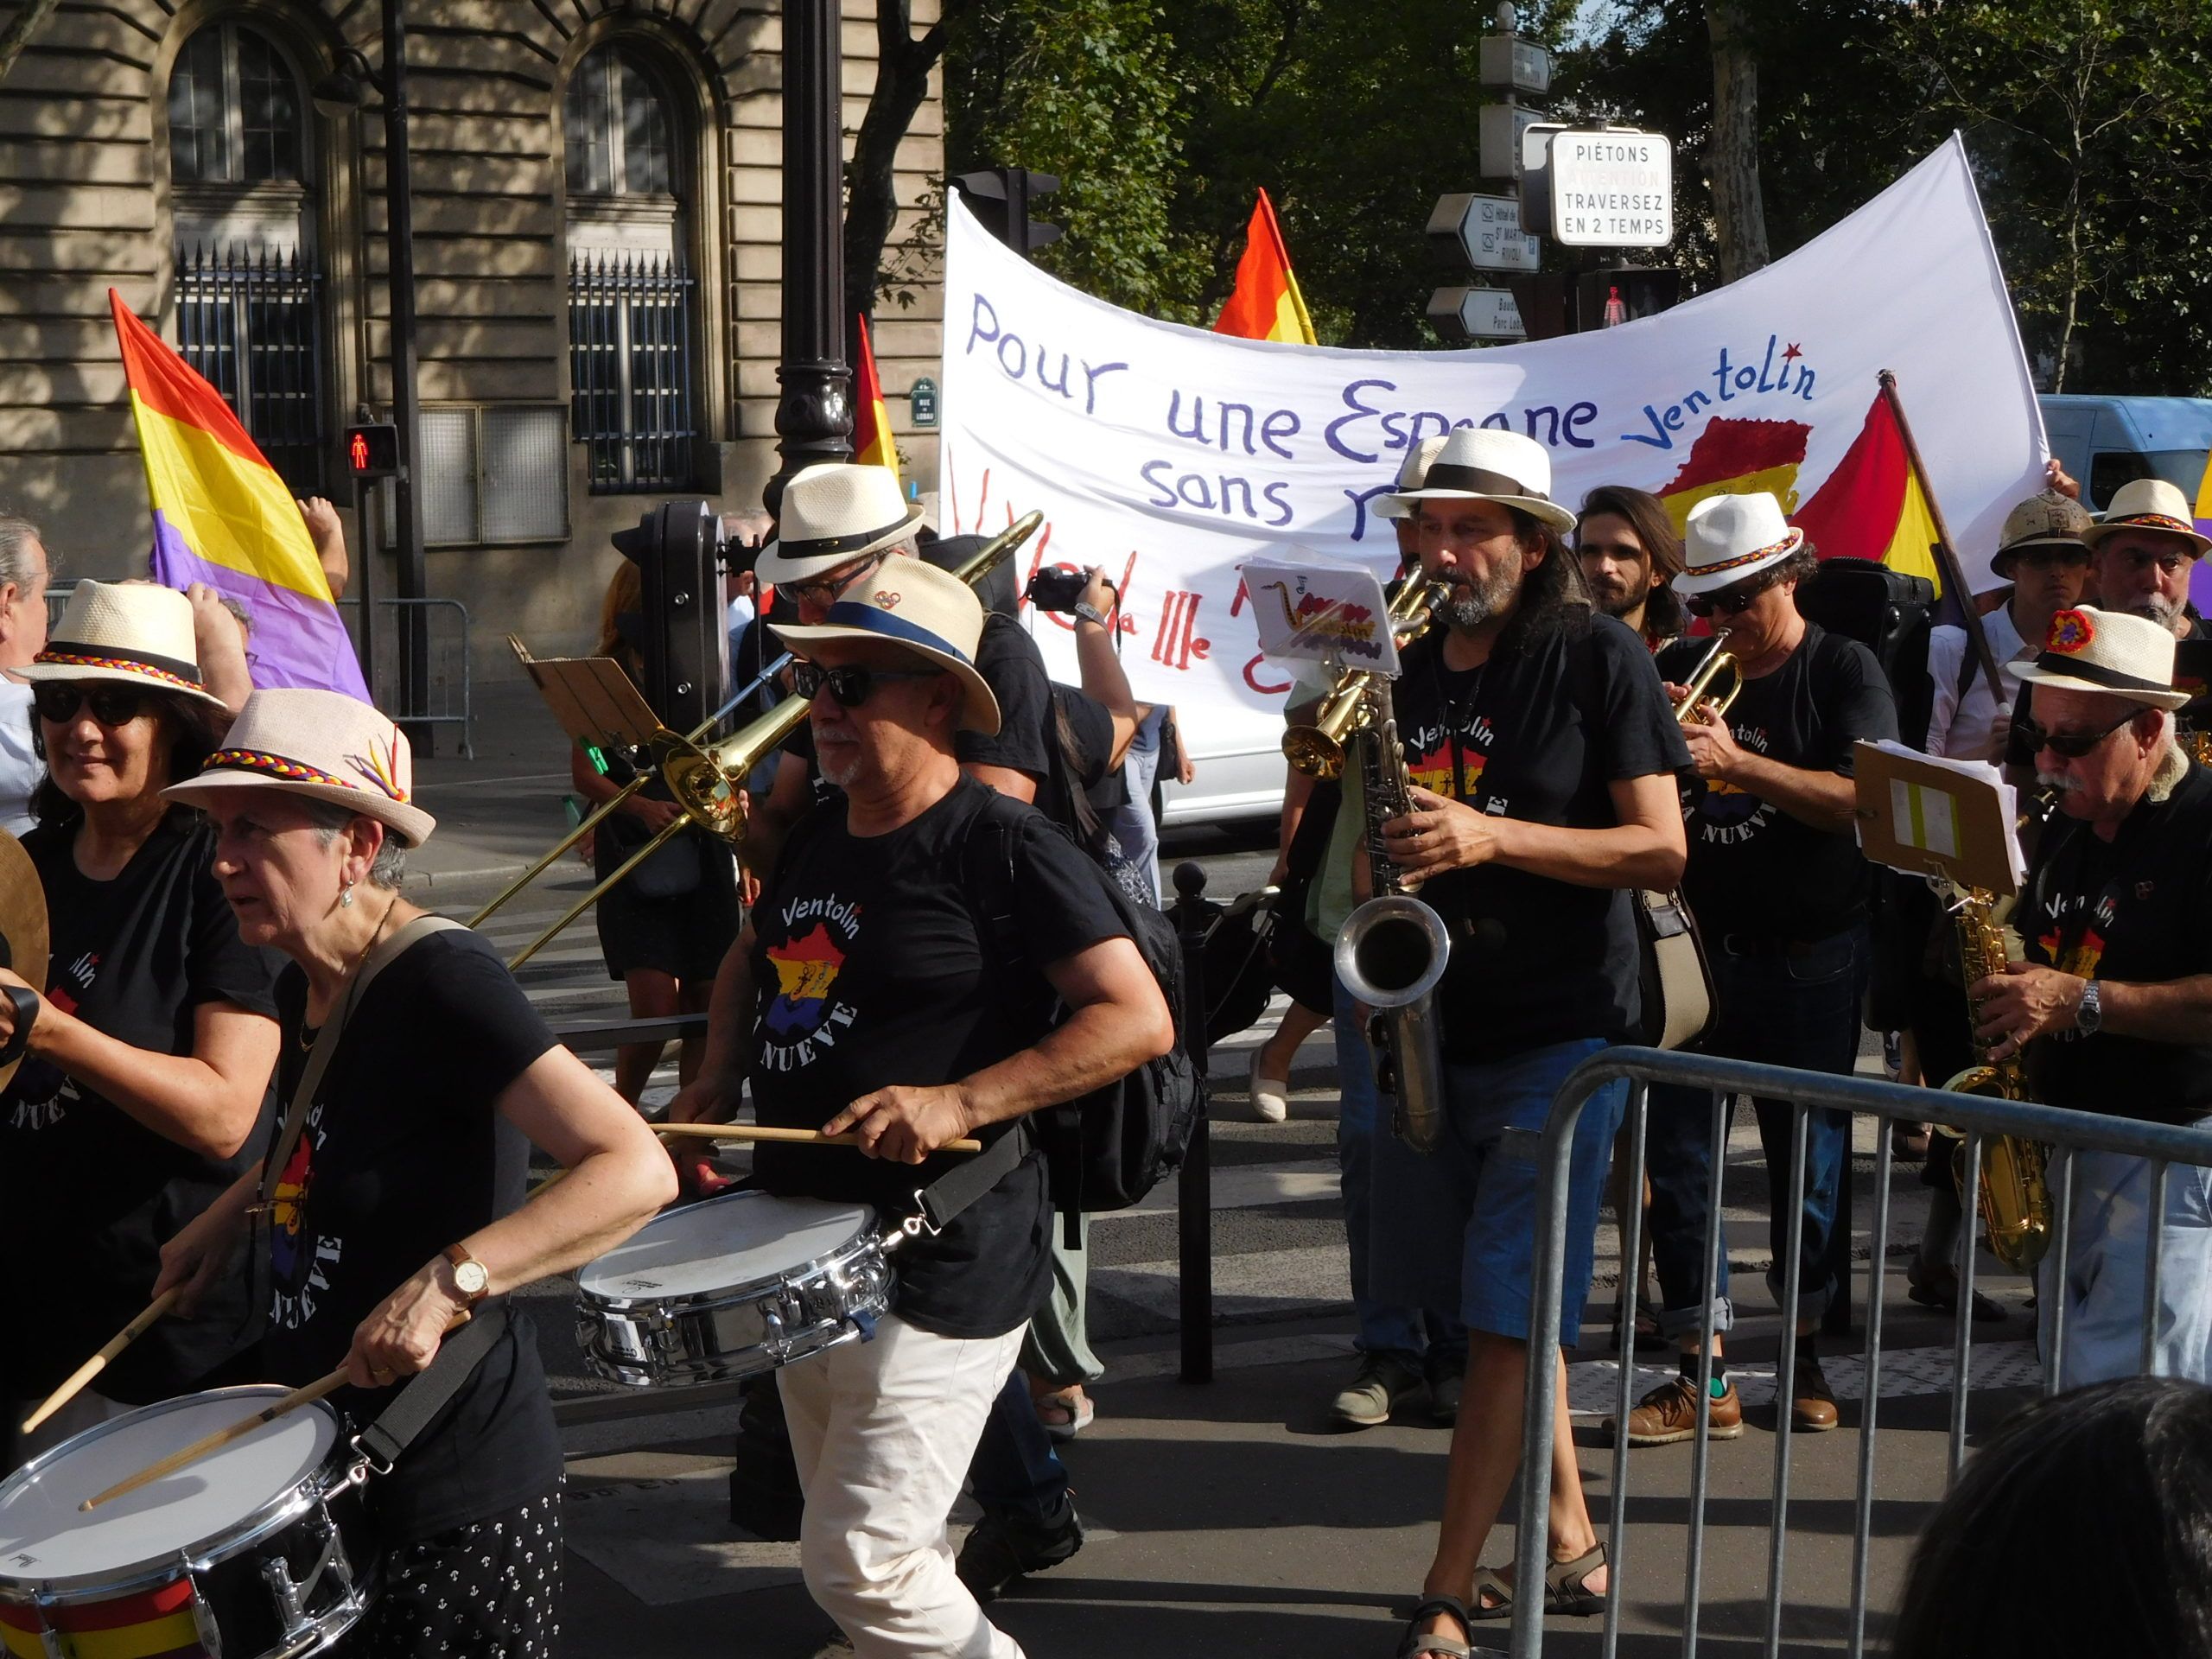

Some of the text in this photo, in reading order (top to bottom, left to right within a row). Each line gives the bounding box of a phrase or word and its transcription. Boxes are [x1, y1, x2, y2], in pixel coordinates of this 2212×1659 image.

[1576, 142, 1649, 162] PIÉTONS
[1565, 194, 1662, 211] TRAVERSEZ
[1565, 218, 1663, 234] EN 2 TEMPS
[966, 292, 1128, 415] Pour
[1166, 389, 1301, 460] une
[782, 892, 861, 940] Ventolin
[760, 1001, 858, 1072] NUEVE
[10, 1074, 81, 1131] NUEV
